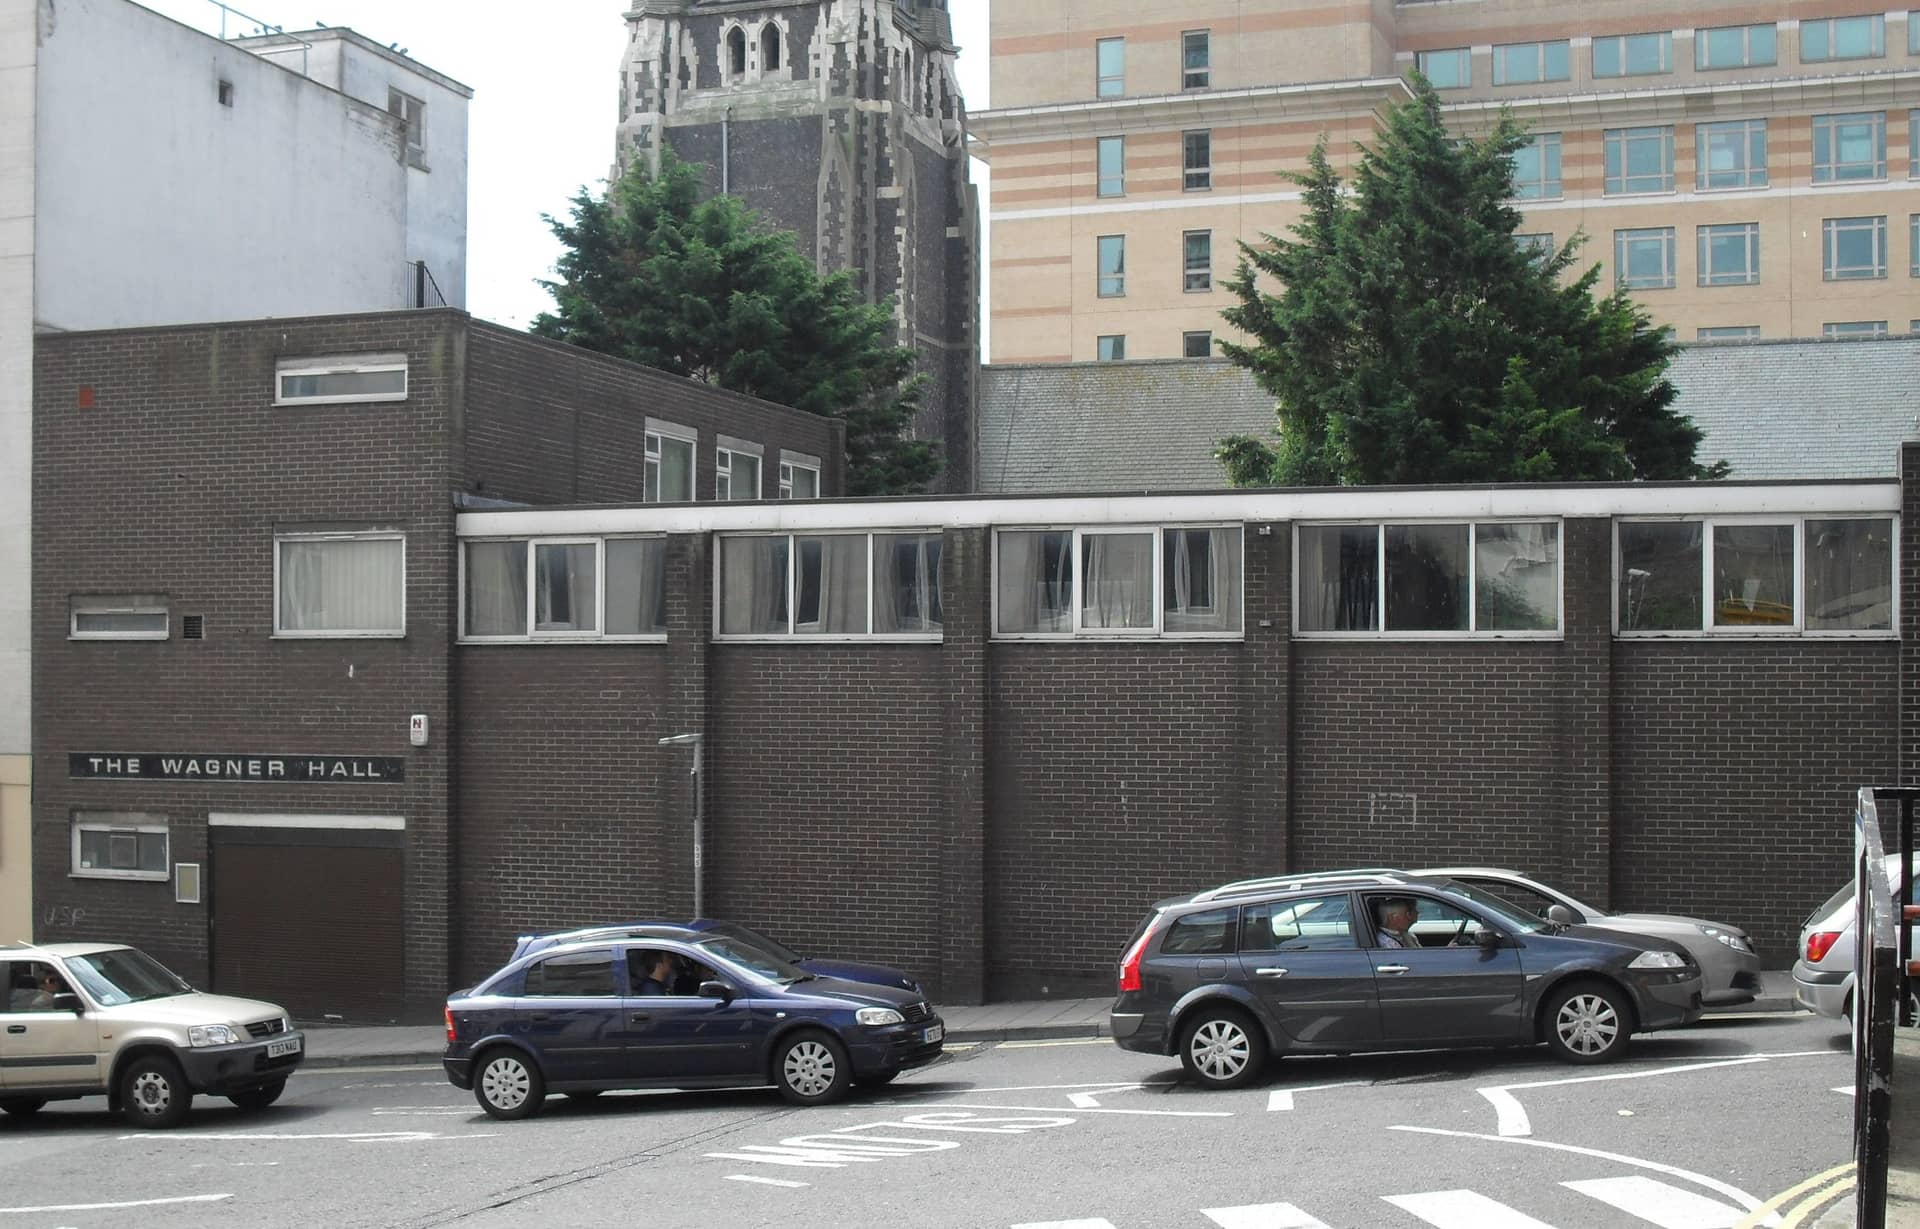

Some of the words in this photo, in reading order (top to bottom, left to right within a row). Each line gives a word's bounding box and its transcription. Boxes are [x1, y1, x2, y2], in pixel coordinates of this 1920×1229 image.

[89, 758, 141, 774] THE
[162, 758, 285, 776] WAGNER
[309, 761, 381, 777] HALL
[701, 1113, 1077, 1168] SLOW
